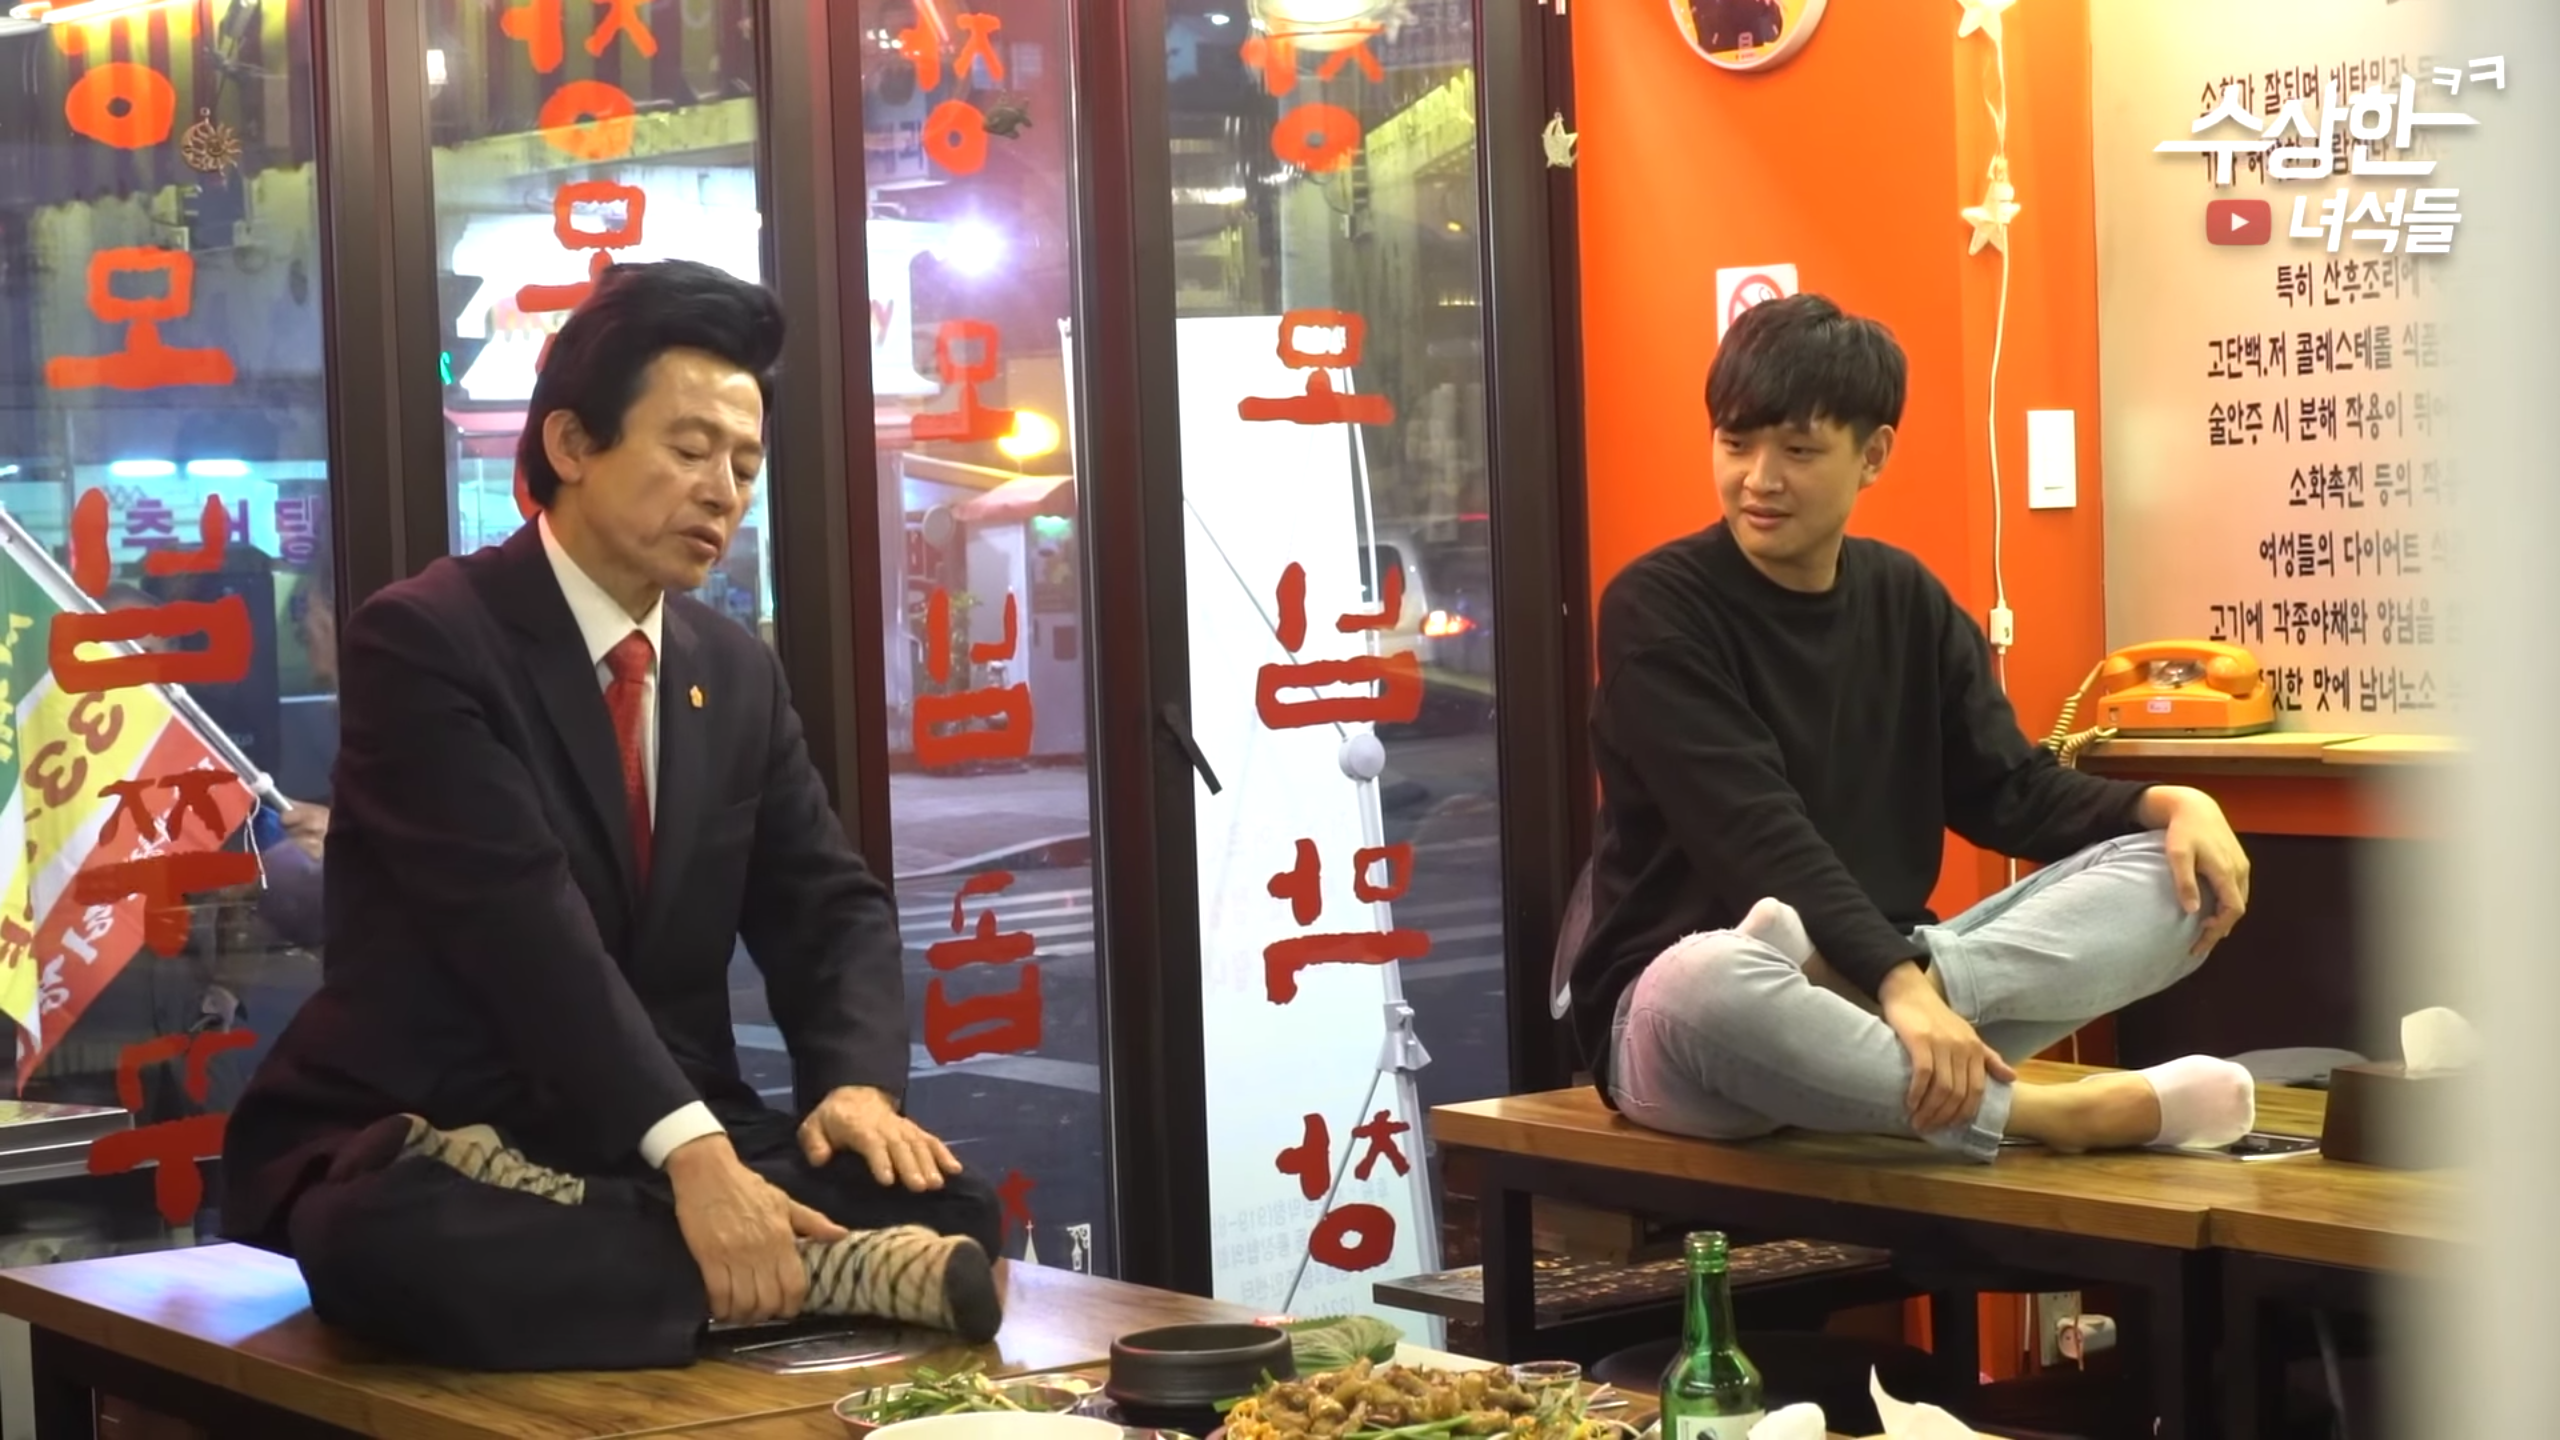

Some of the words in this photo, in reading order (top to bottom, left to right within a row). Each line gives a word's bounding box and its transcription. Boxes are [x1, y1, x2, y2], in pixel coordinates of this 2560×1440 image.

[2276, 262, 2313, 308] 특히
[2296, 325, 2393, 376] 콜레스테롤
[2208, 400, 2263, 446] 술안주
[2273, 397, 2290, 443] 시
[2299, 395, 2337, 442] 분해
[2346, 391, 2403, 440] 작용이
[2289, 461, 2365, 509] 소화촉진
[2374, 459, 2412, 507] 등의
[2259, 530, 2335, 578] 여성들의
[2343, 528, 2422, 577] 다이어트
[2209, 600, 2263, 645] 고기에
[2272, 598, 2368, 646] 각종야채와
[2377, 597, 2435, 645] 양념을
[2258, 665, 2303, 712] 깃한
[2313, 665, 2351, 712] 맛에
[2360, 665, 2436, 714] 남녀노소
